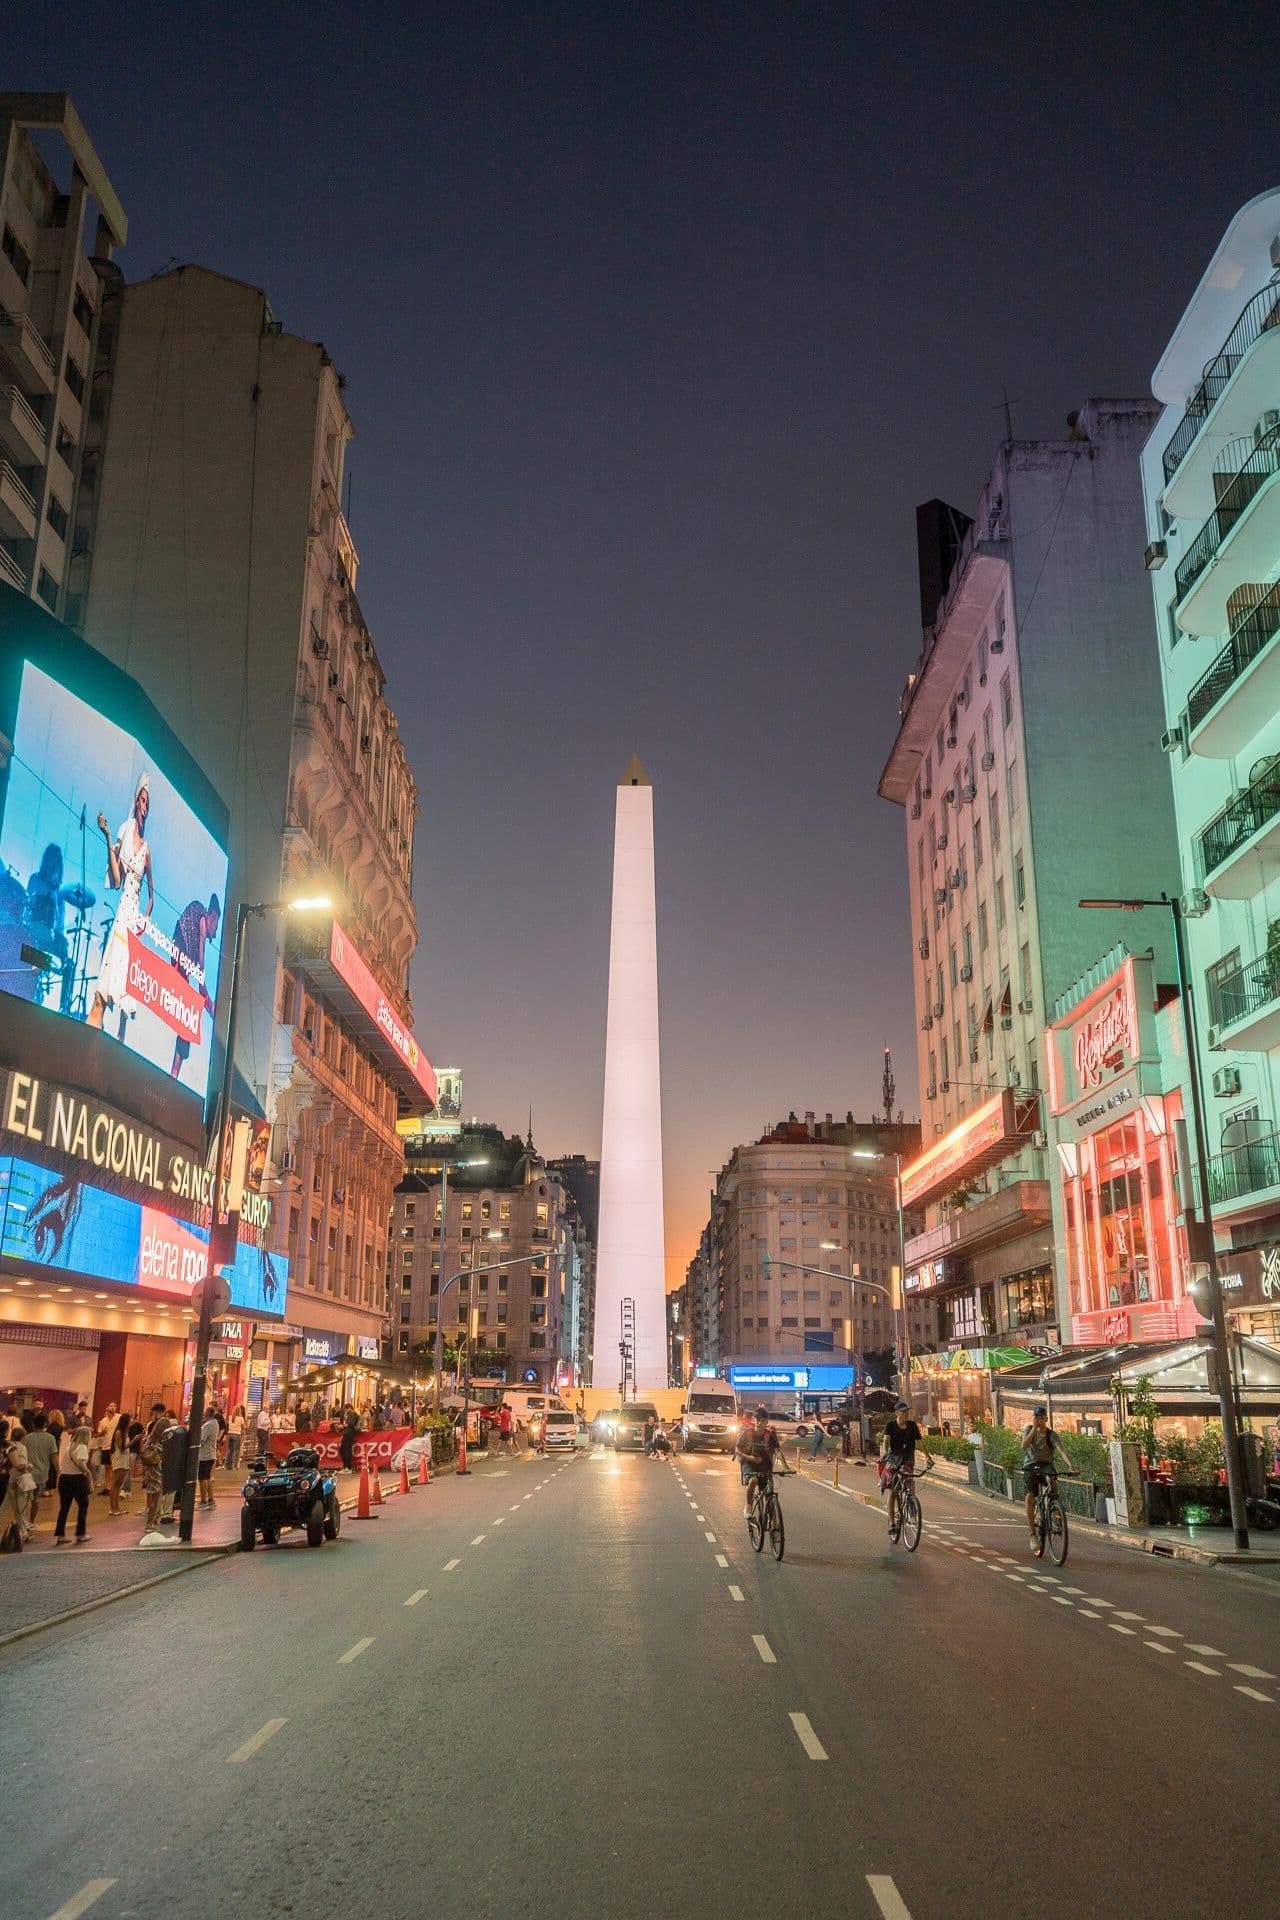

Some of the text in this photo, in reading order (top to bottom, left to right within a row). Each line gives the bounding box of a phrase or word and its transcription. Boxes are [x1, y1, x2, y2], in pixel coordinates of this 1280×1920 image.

[129, 957, 199, 1035] diego reinhold
[1076, 988, 1130, 1089] Kentucky
[7, 1071, 43, 1141] EL
[51, 1092, 164, 1190] NACIONAL
[141, 1226, 178, 1280] elena
[291, 1441, 392, 1458] osaza
